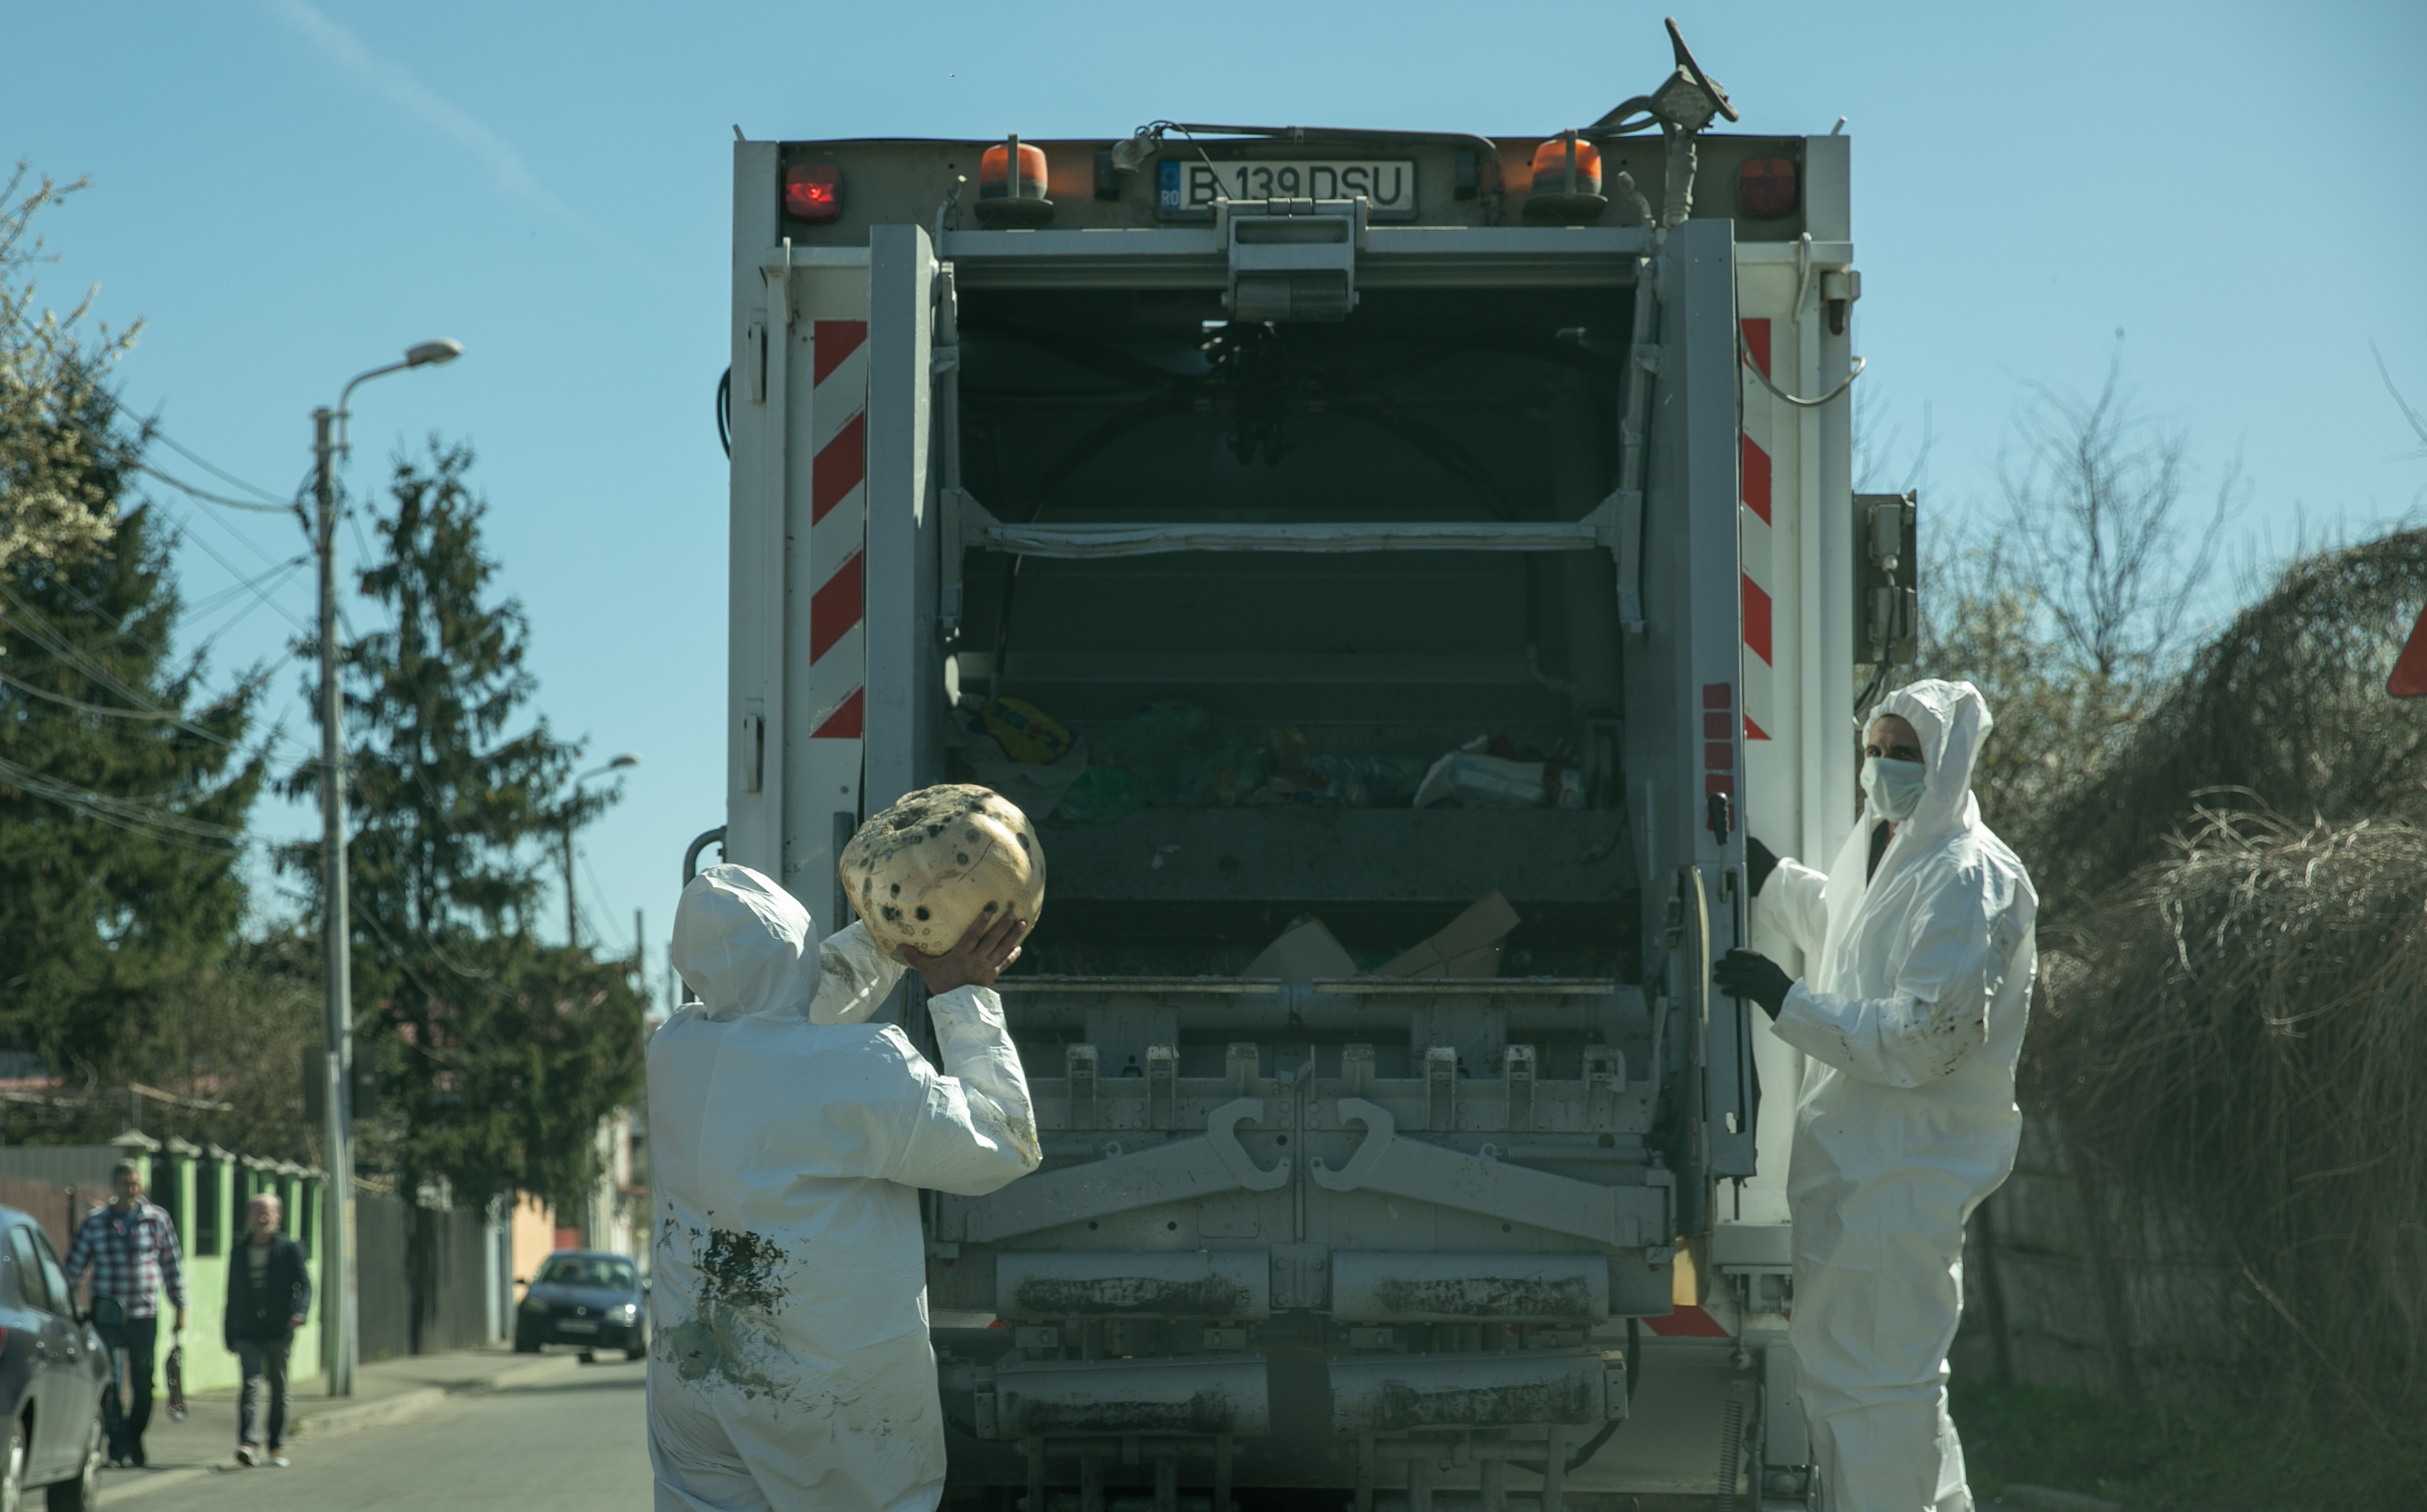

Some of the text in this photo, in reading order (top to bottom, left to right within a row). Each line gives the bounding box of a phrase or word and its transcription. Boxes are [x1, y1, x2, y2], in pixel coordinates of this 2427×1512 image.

[1161, 190, 1179, 206] RO
[1190, 166, 1401, 206] B 139 DSU
